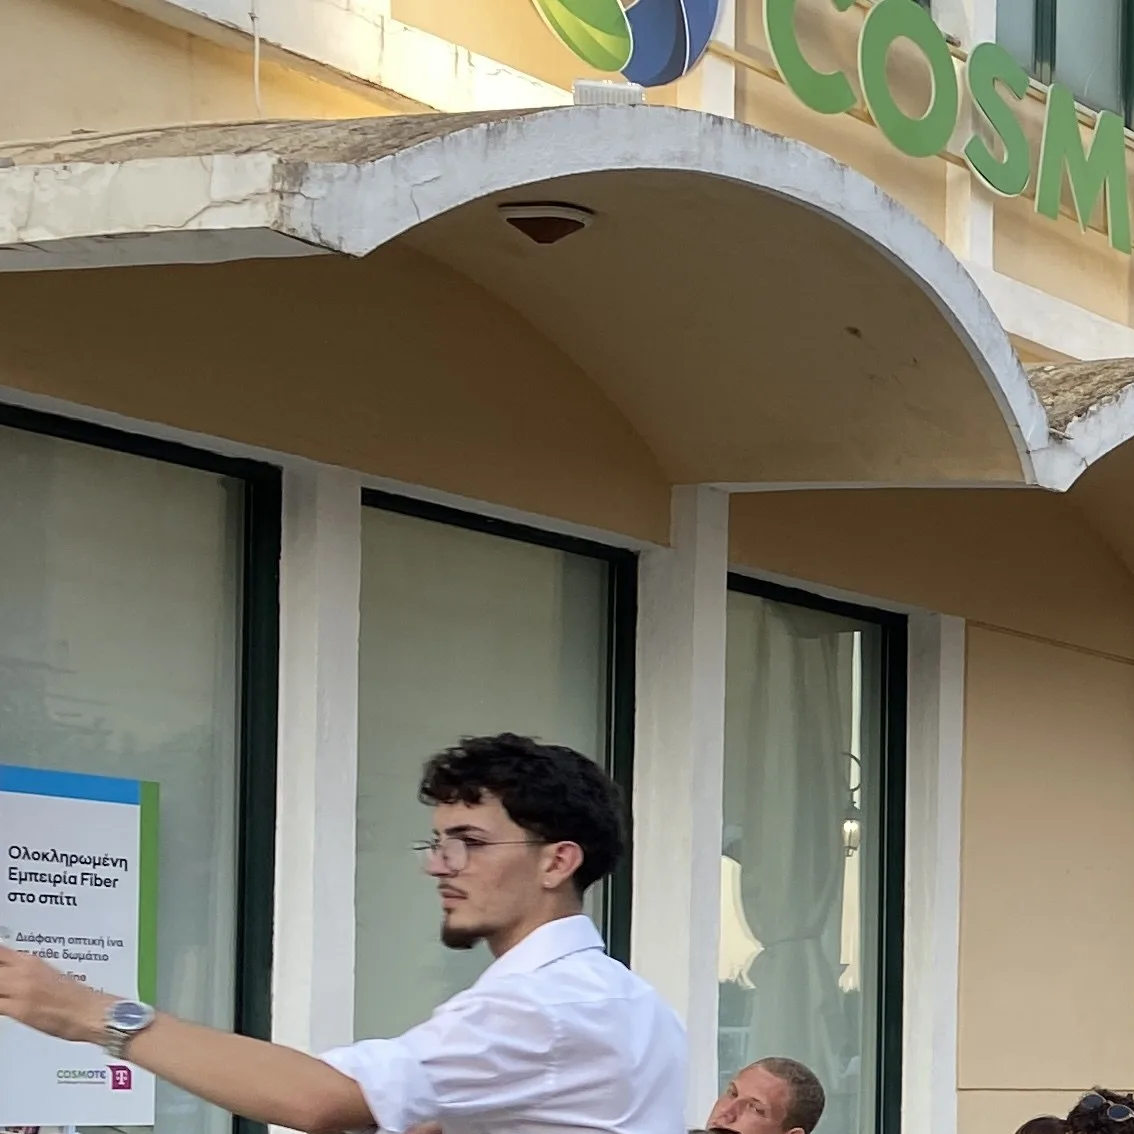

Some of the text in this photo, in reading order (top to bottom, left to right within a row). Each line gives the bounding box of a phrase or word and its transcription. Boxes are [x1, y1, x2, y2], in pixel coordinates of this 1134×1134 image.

[8, 845, 128, 872] Ολοκληρωμένη
[8, 867, 119, 888] Εμπειρία Fiber
[7, 891, 78, 907] στο σπίτι
[16, 932, 125, 949] Διάφανη οπτική ίνα
[62, 949, 110, 962] δωμάτιο
[56, 1069, 107, 1080] COSMOTE
